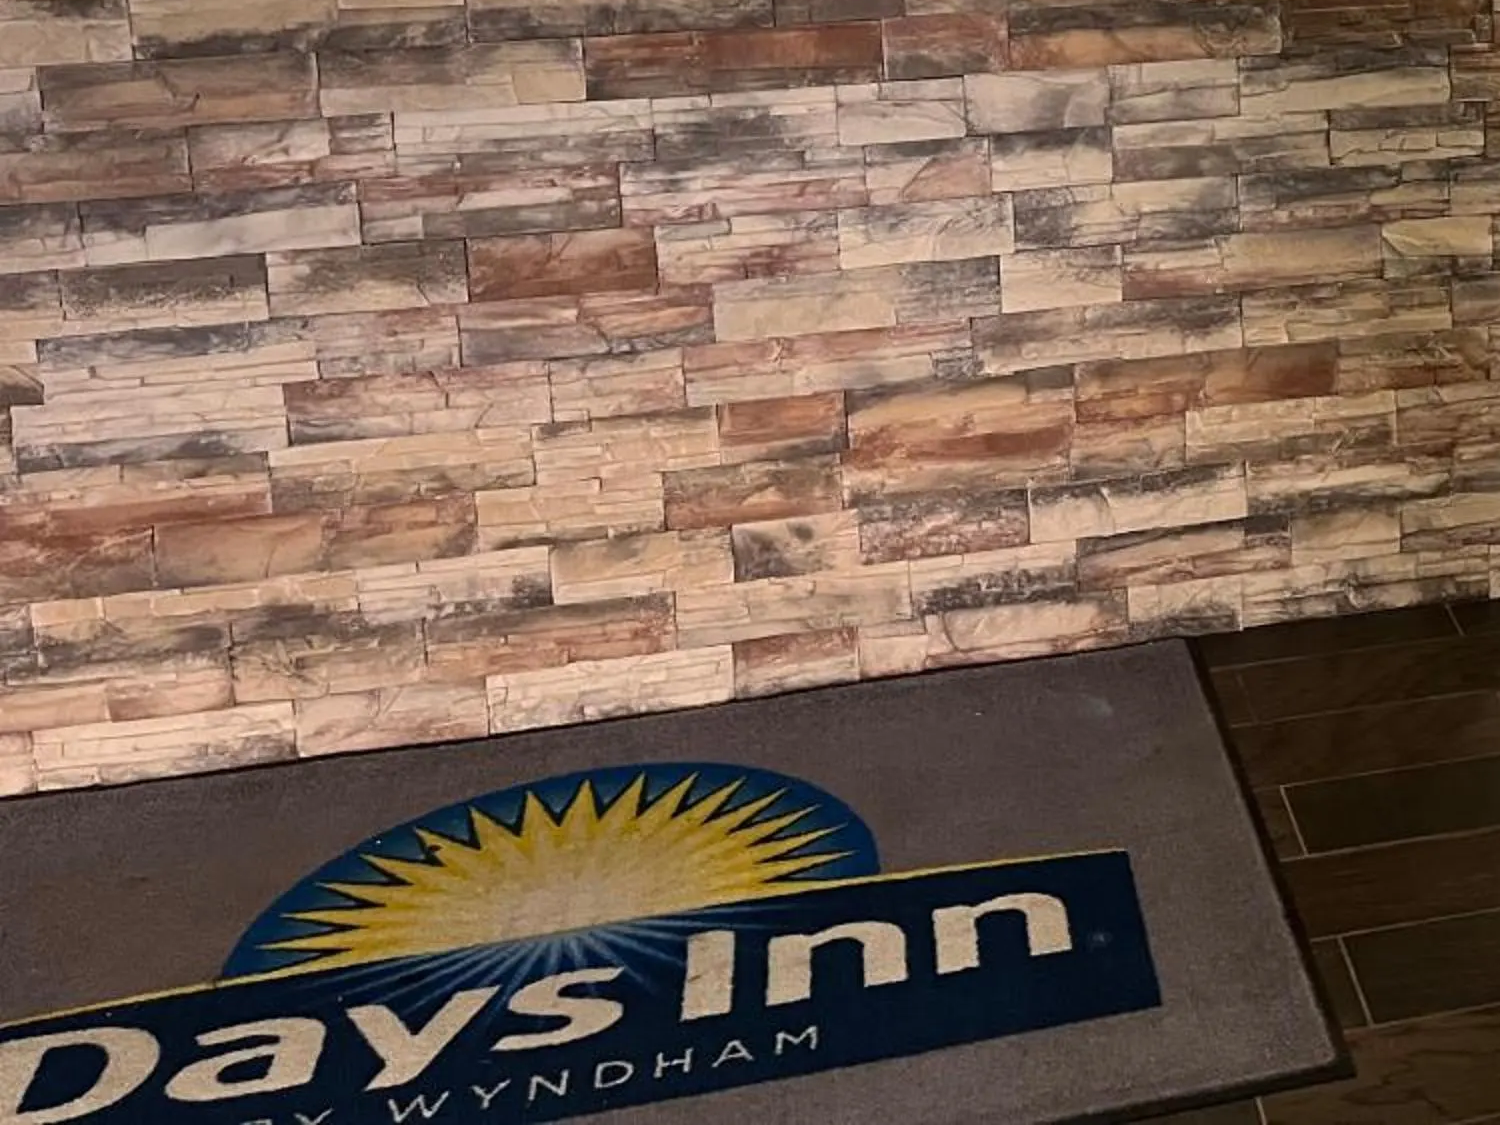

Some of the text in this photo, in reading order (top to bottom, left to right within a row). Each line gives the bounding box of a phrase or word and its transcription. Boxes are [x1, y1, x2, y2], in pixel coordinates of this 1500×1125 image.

[0, 892, 1073, 1125] Days Inn
[238, 1025, 820, 1125] Y WYNDHAM
